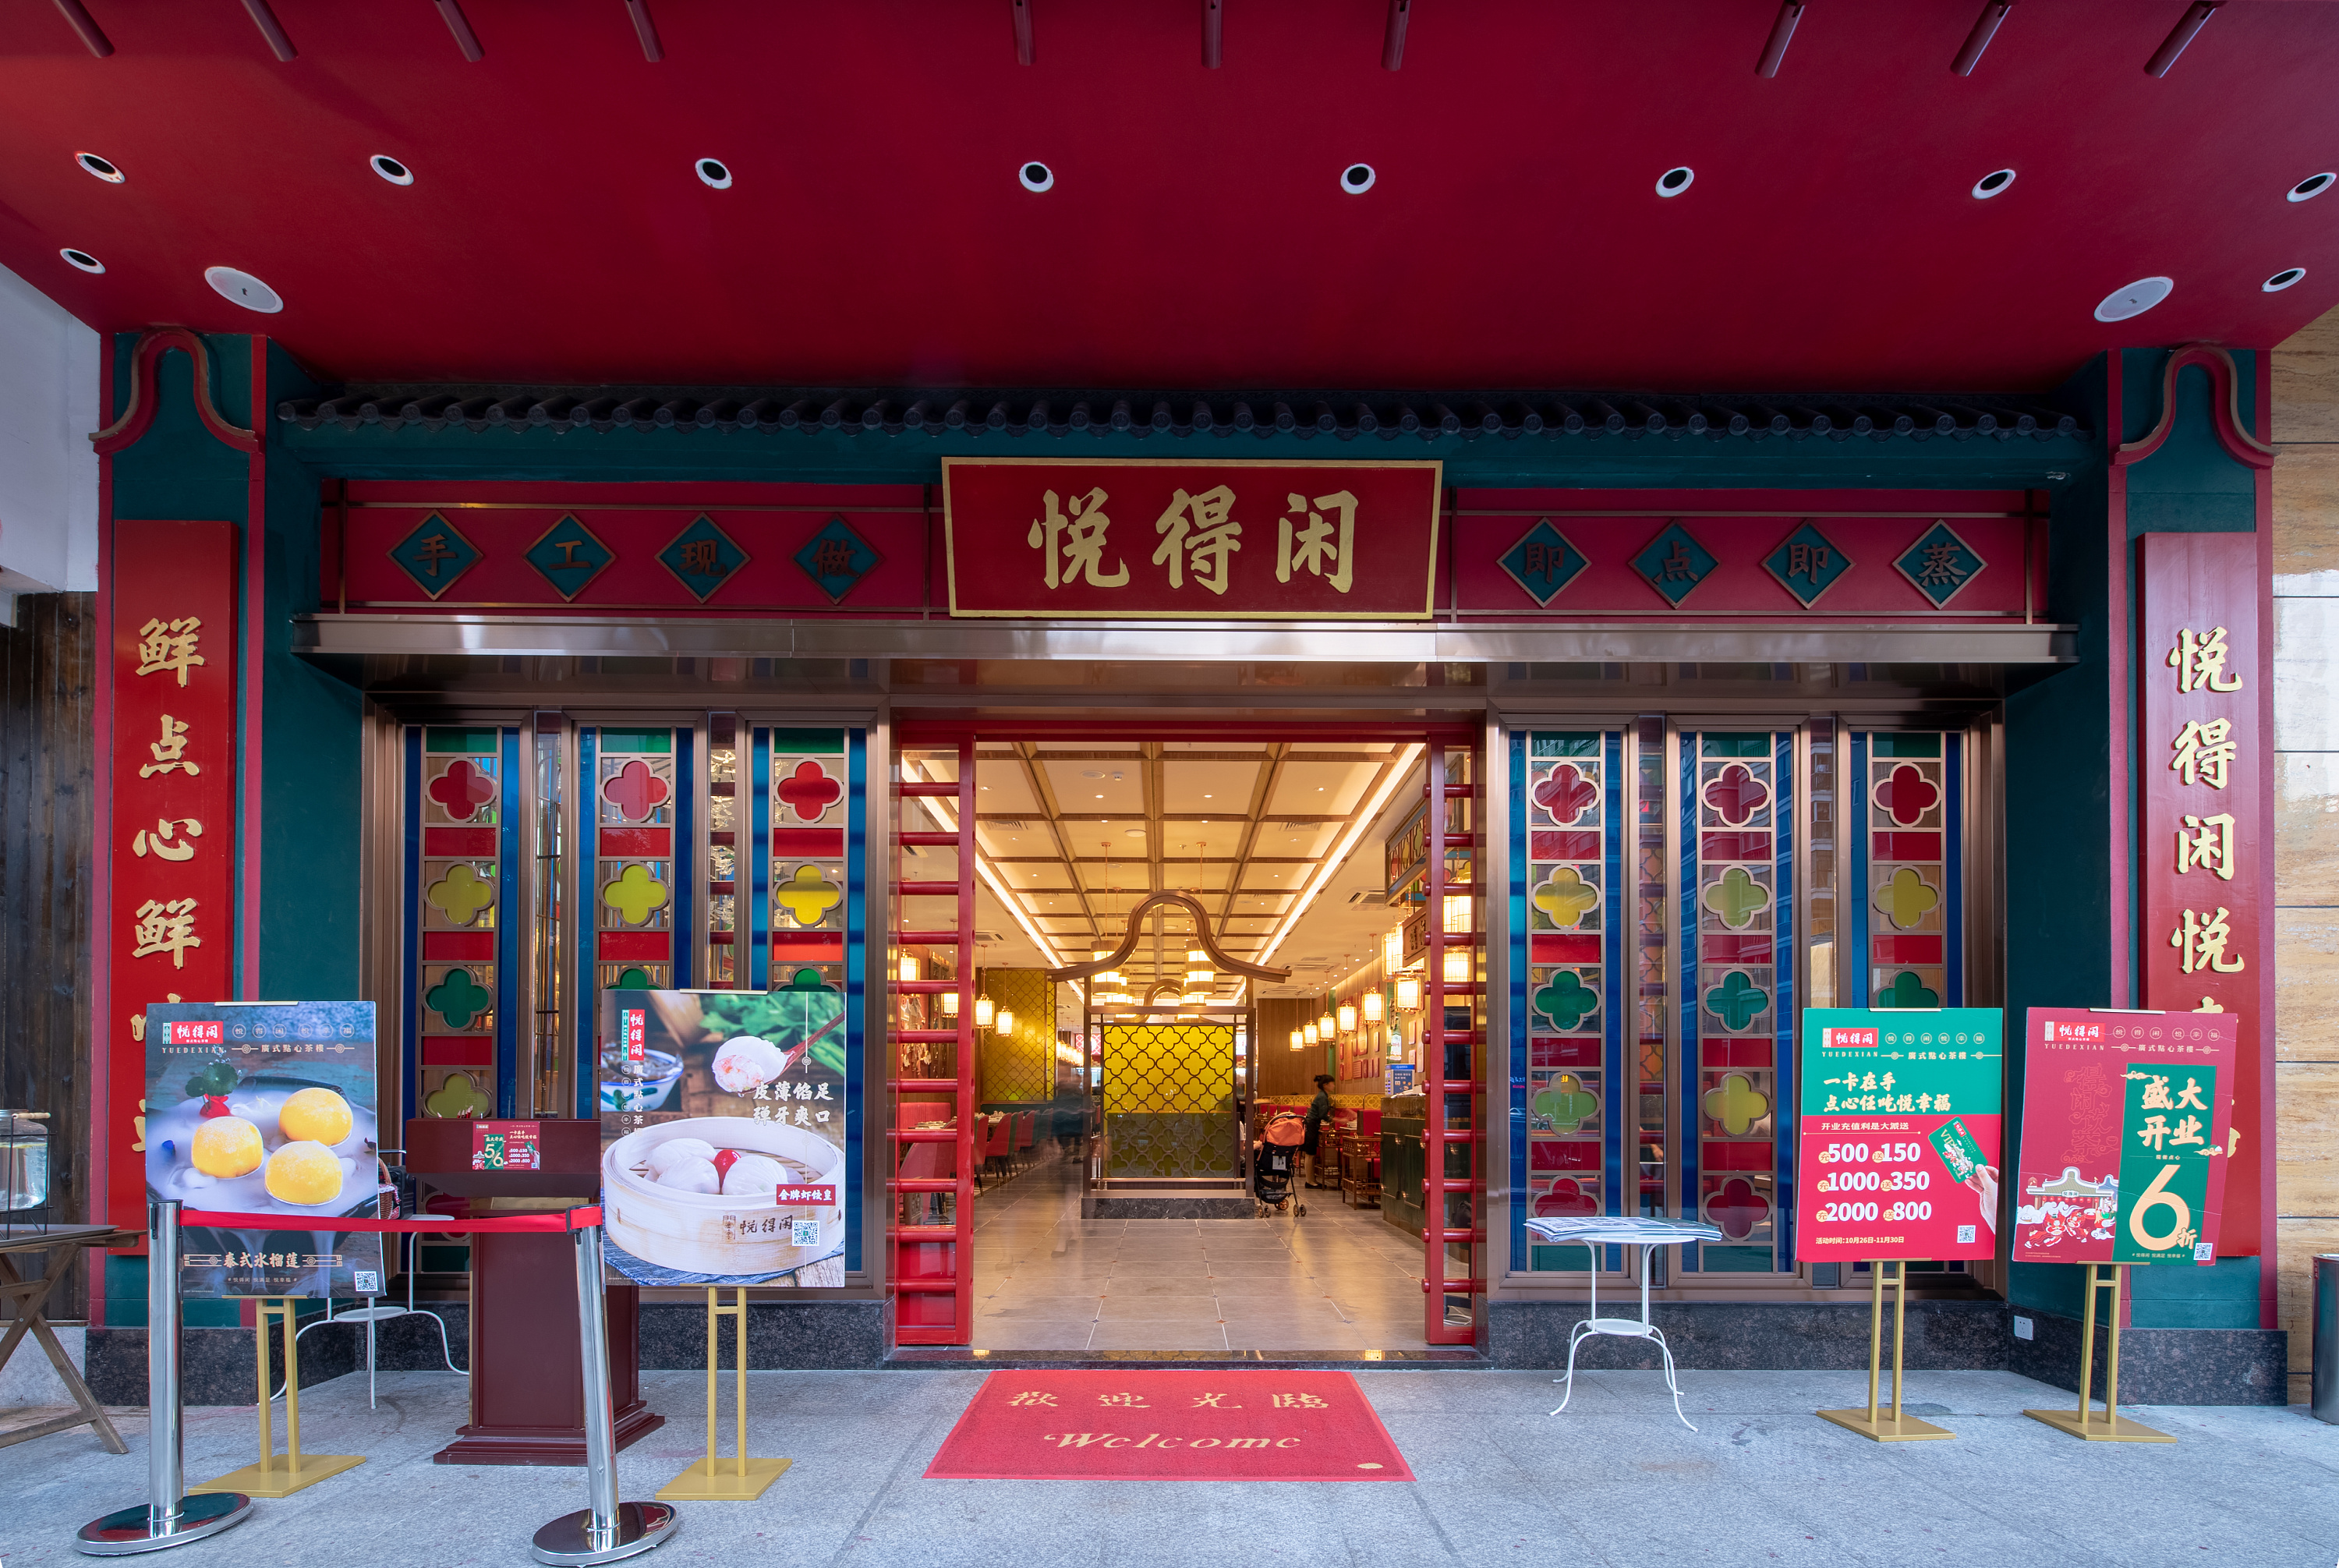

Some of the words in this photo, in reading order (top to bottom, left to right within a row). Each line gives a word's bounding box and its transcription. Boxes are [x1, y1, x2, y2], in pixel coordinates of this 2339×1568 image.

[1027, 484, 1359, 595] 悦得闲
[413, 533, 862, 579] 手工现做
[1523, 540, 1967, 587] 即点即蒸
[131, 616, 206, 1152] 鲜点心鲜
[2169, 627, 2245, 1159] 悦得闲悦
[177, 1025, 218, 1039] 悦得闲
[630, 1014, 643, 1057] 悦得闲
[1836, 1032, 1873, 1045] 悦得闲
[2059, 1024, 2099, 1038] 悦得闲
[261, 1044, 324, 1053] 廣式點心茶樓
[2138, 1044, 2193, 1053] 廣式點心茶樓
[753, 1081, 834, 1102] 皮薄馅足
[1823, 1071, 1896, 1092] 一卡在手
[2140, 1074, 2208, 1110] 盛大
[1823, 1092, 1952, 1113] 点心任吃悦幸福
[753, 1106, 830, 1127] 弹牙爽口
[1821, 1122, 1909, 1131] 开业充值利是大派送
[2137, 1115, 2205, 1151] 开业
[777, 1188, 833, 1202] 金牌虾饺皇
[740, 1215, 793, 1234] 悦得闲
[223, 1251, 301, 1269] 泰式冰榴莲
